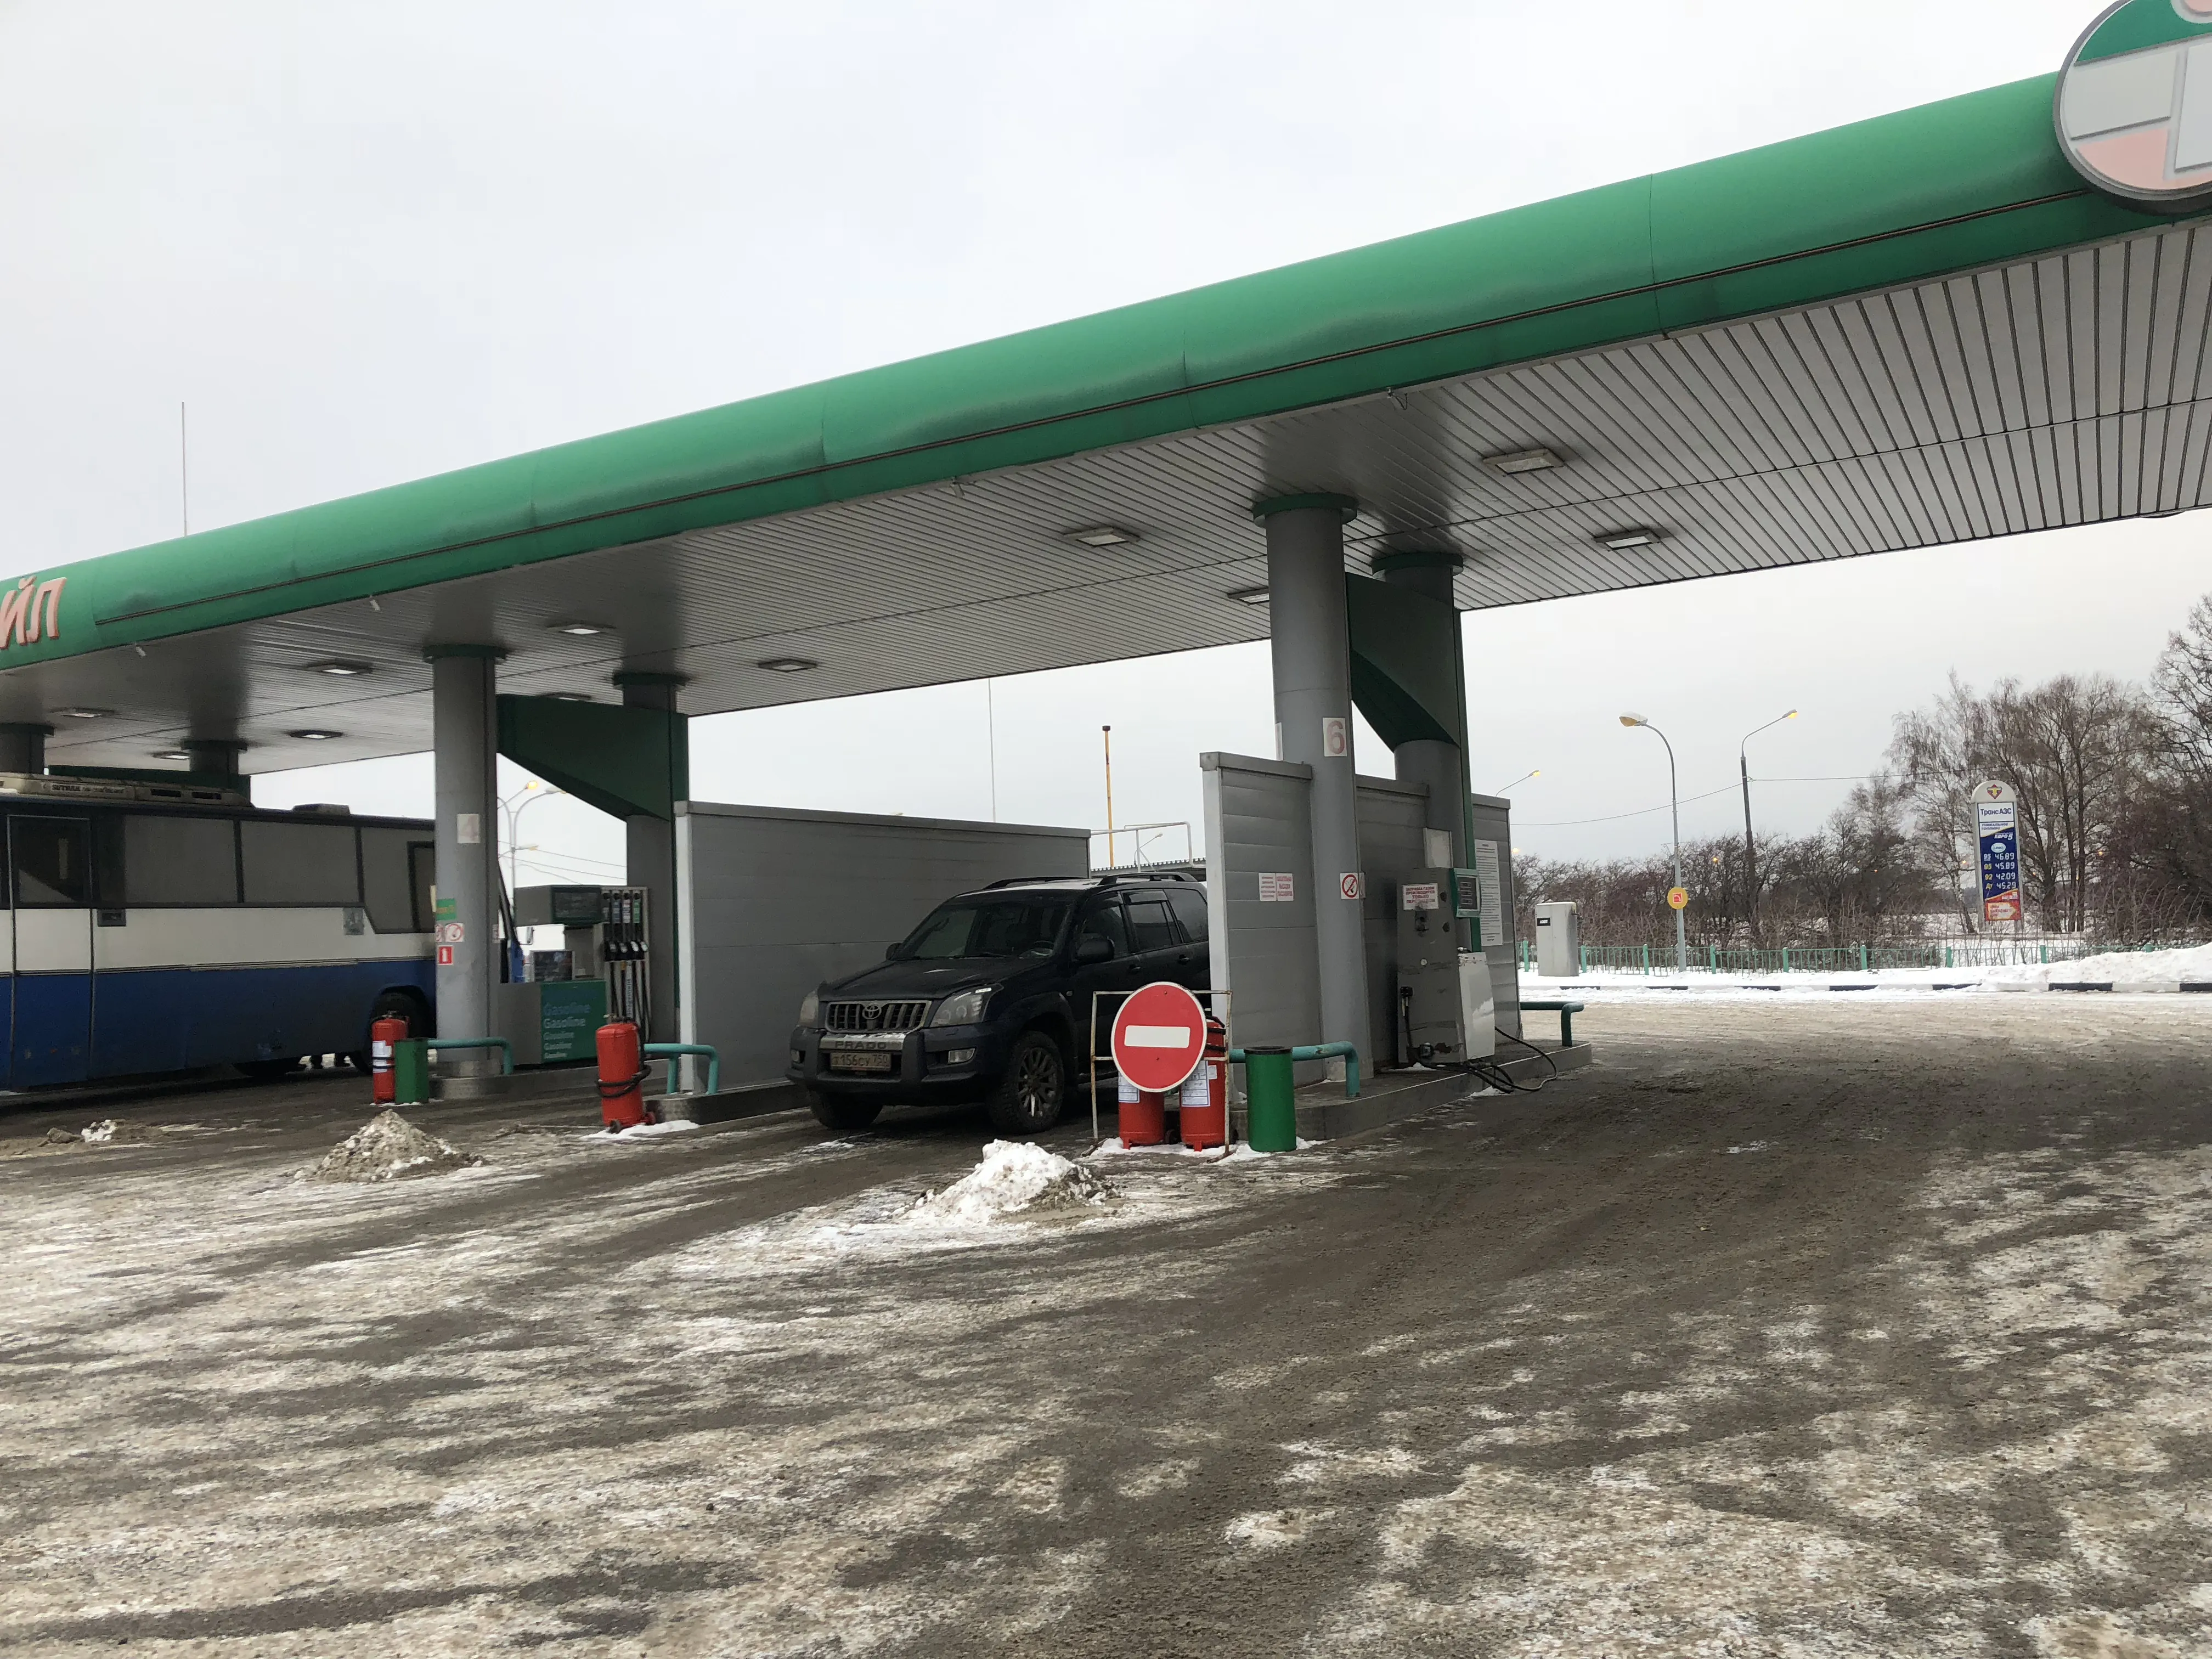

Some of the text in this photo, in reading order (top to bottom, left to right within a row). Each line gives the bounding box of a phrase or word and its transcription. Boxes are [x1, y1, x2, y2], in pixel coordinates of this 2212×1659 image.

[1327, 720, 1345, 754] 6
[544, 1016, 586, 1029] Gasoline
[834, 1040, 887, 1049] PRADO
